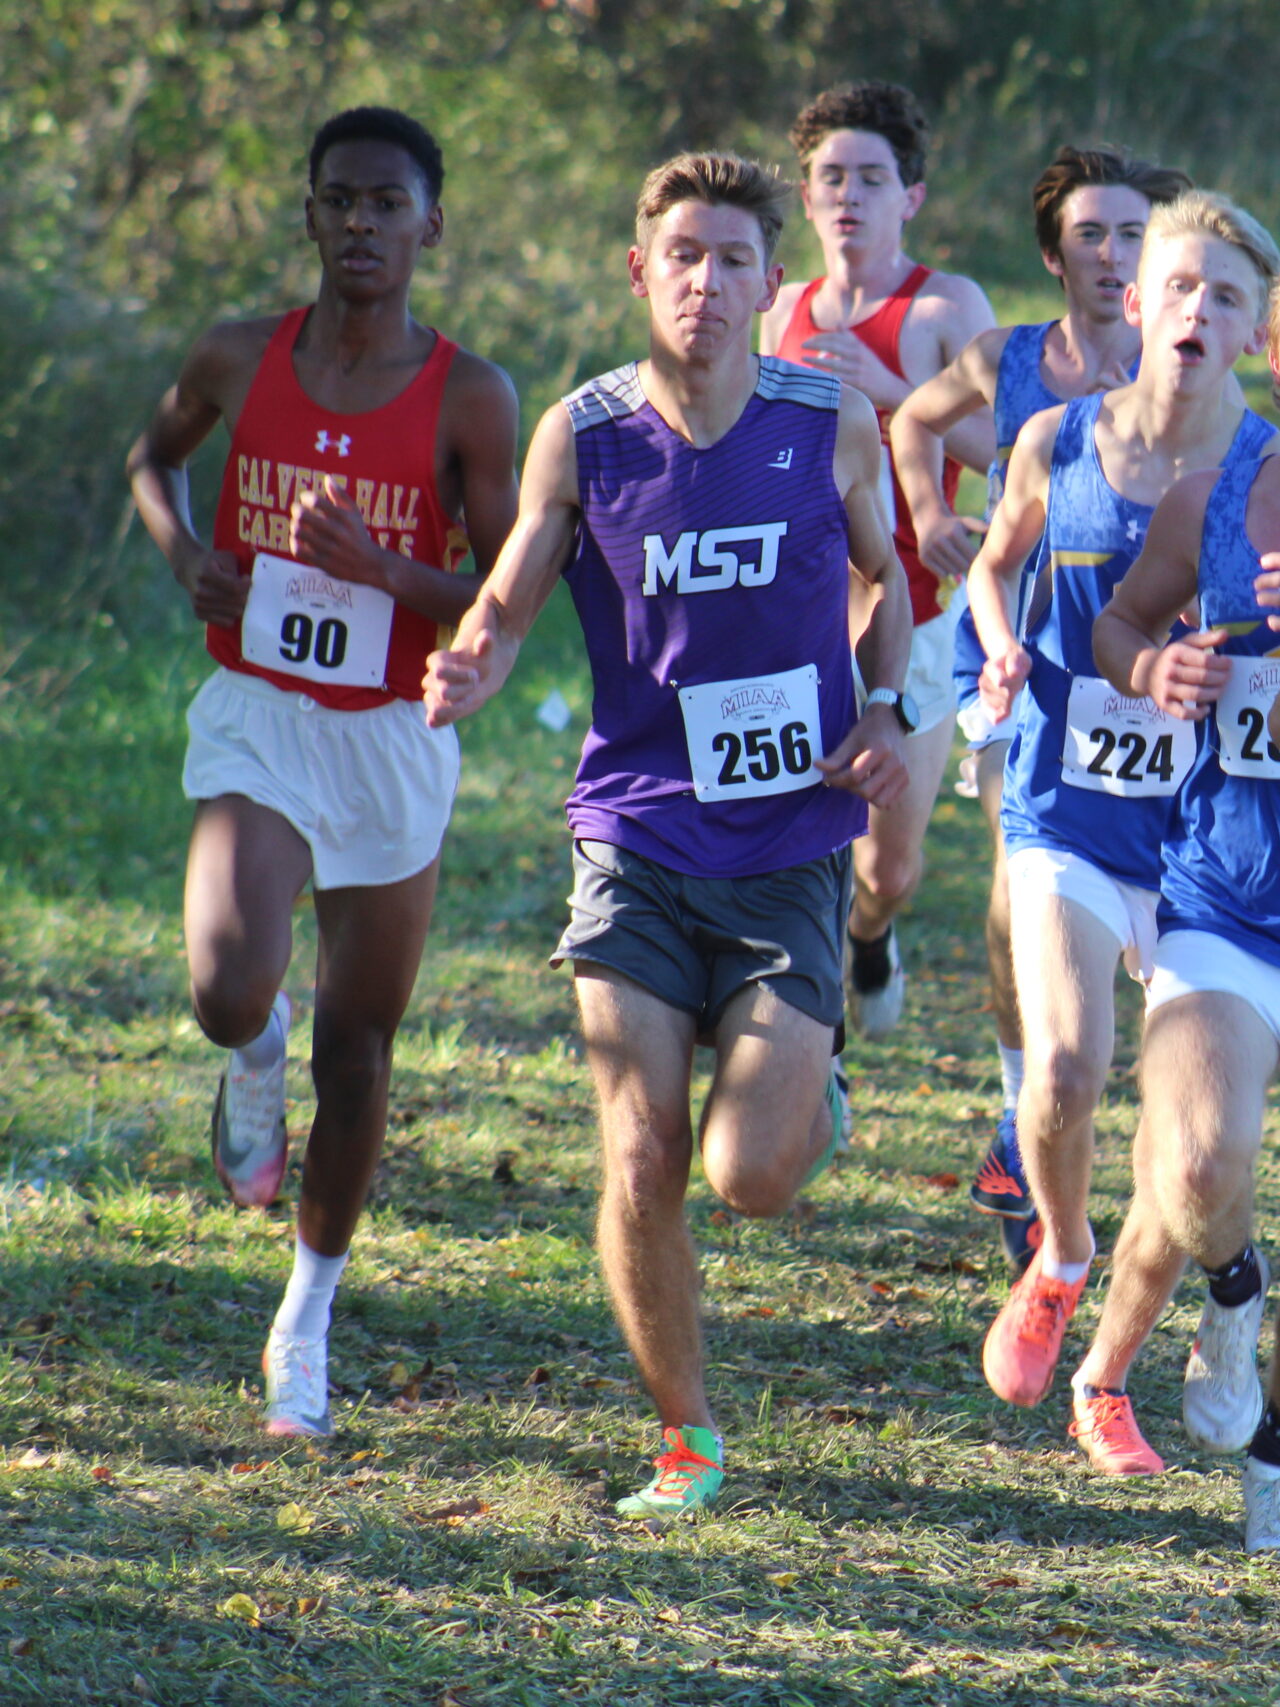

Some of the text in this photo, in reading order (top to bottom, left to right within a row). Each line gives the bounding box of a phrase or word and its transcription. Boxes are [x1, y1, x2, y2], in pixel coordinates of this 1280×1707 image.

[356, 478, 420, 531] HALL
[642, 520, 788, 597] MSJ
[279, 611, 348, 669] 90
[720, 687, 791, 720] MIAA
[711, 720, 812, 786] 256
[1086, 726, 1175, 782] 224
